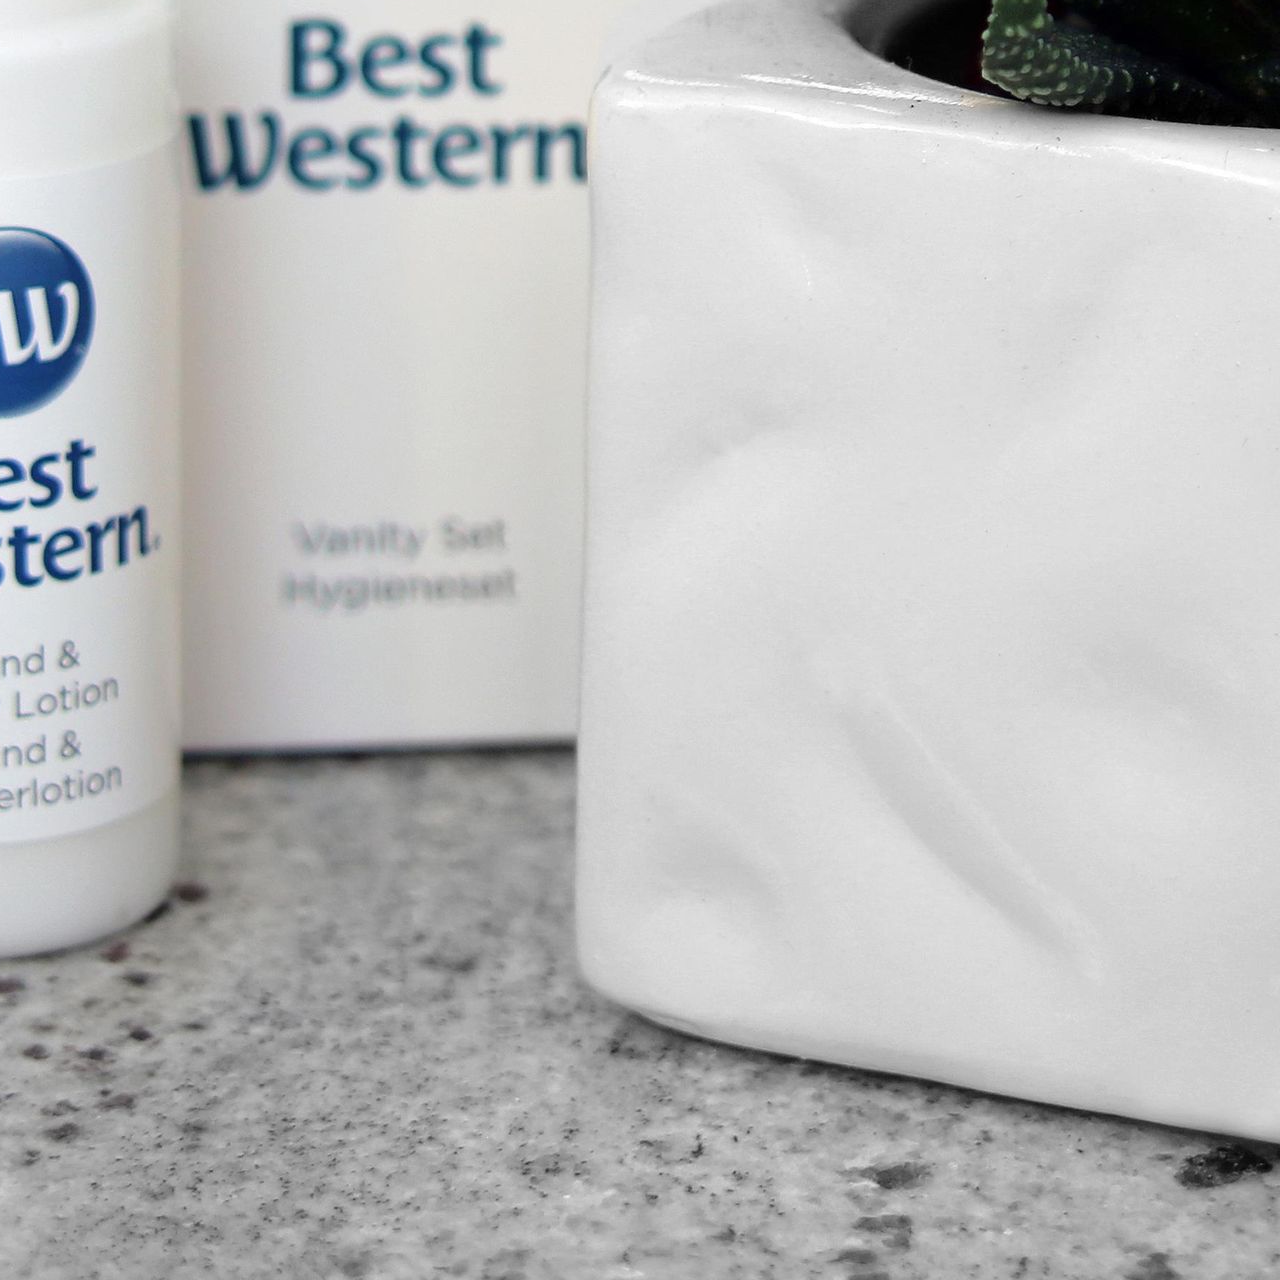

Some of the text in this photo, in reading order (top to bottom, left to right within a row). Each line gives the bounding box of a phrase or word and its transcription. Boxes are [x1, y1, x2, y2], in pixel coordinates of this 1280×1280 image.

[289, 17, 503, 101] Best
[186, 110, 586, 194] Western
[288, 515, 507, 563] Vanity Set
[279, 568, 516, 613] Hygieneset
[58, 640, 81, 670] &
[14, 674, 121, 721] Lotion
[60, 730, 83, 759] &
